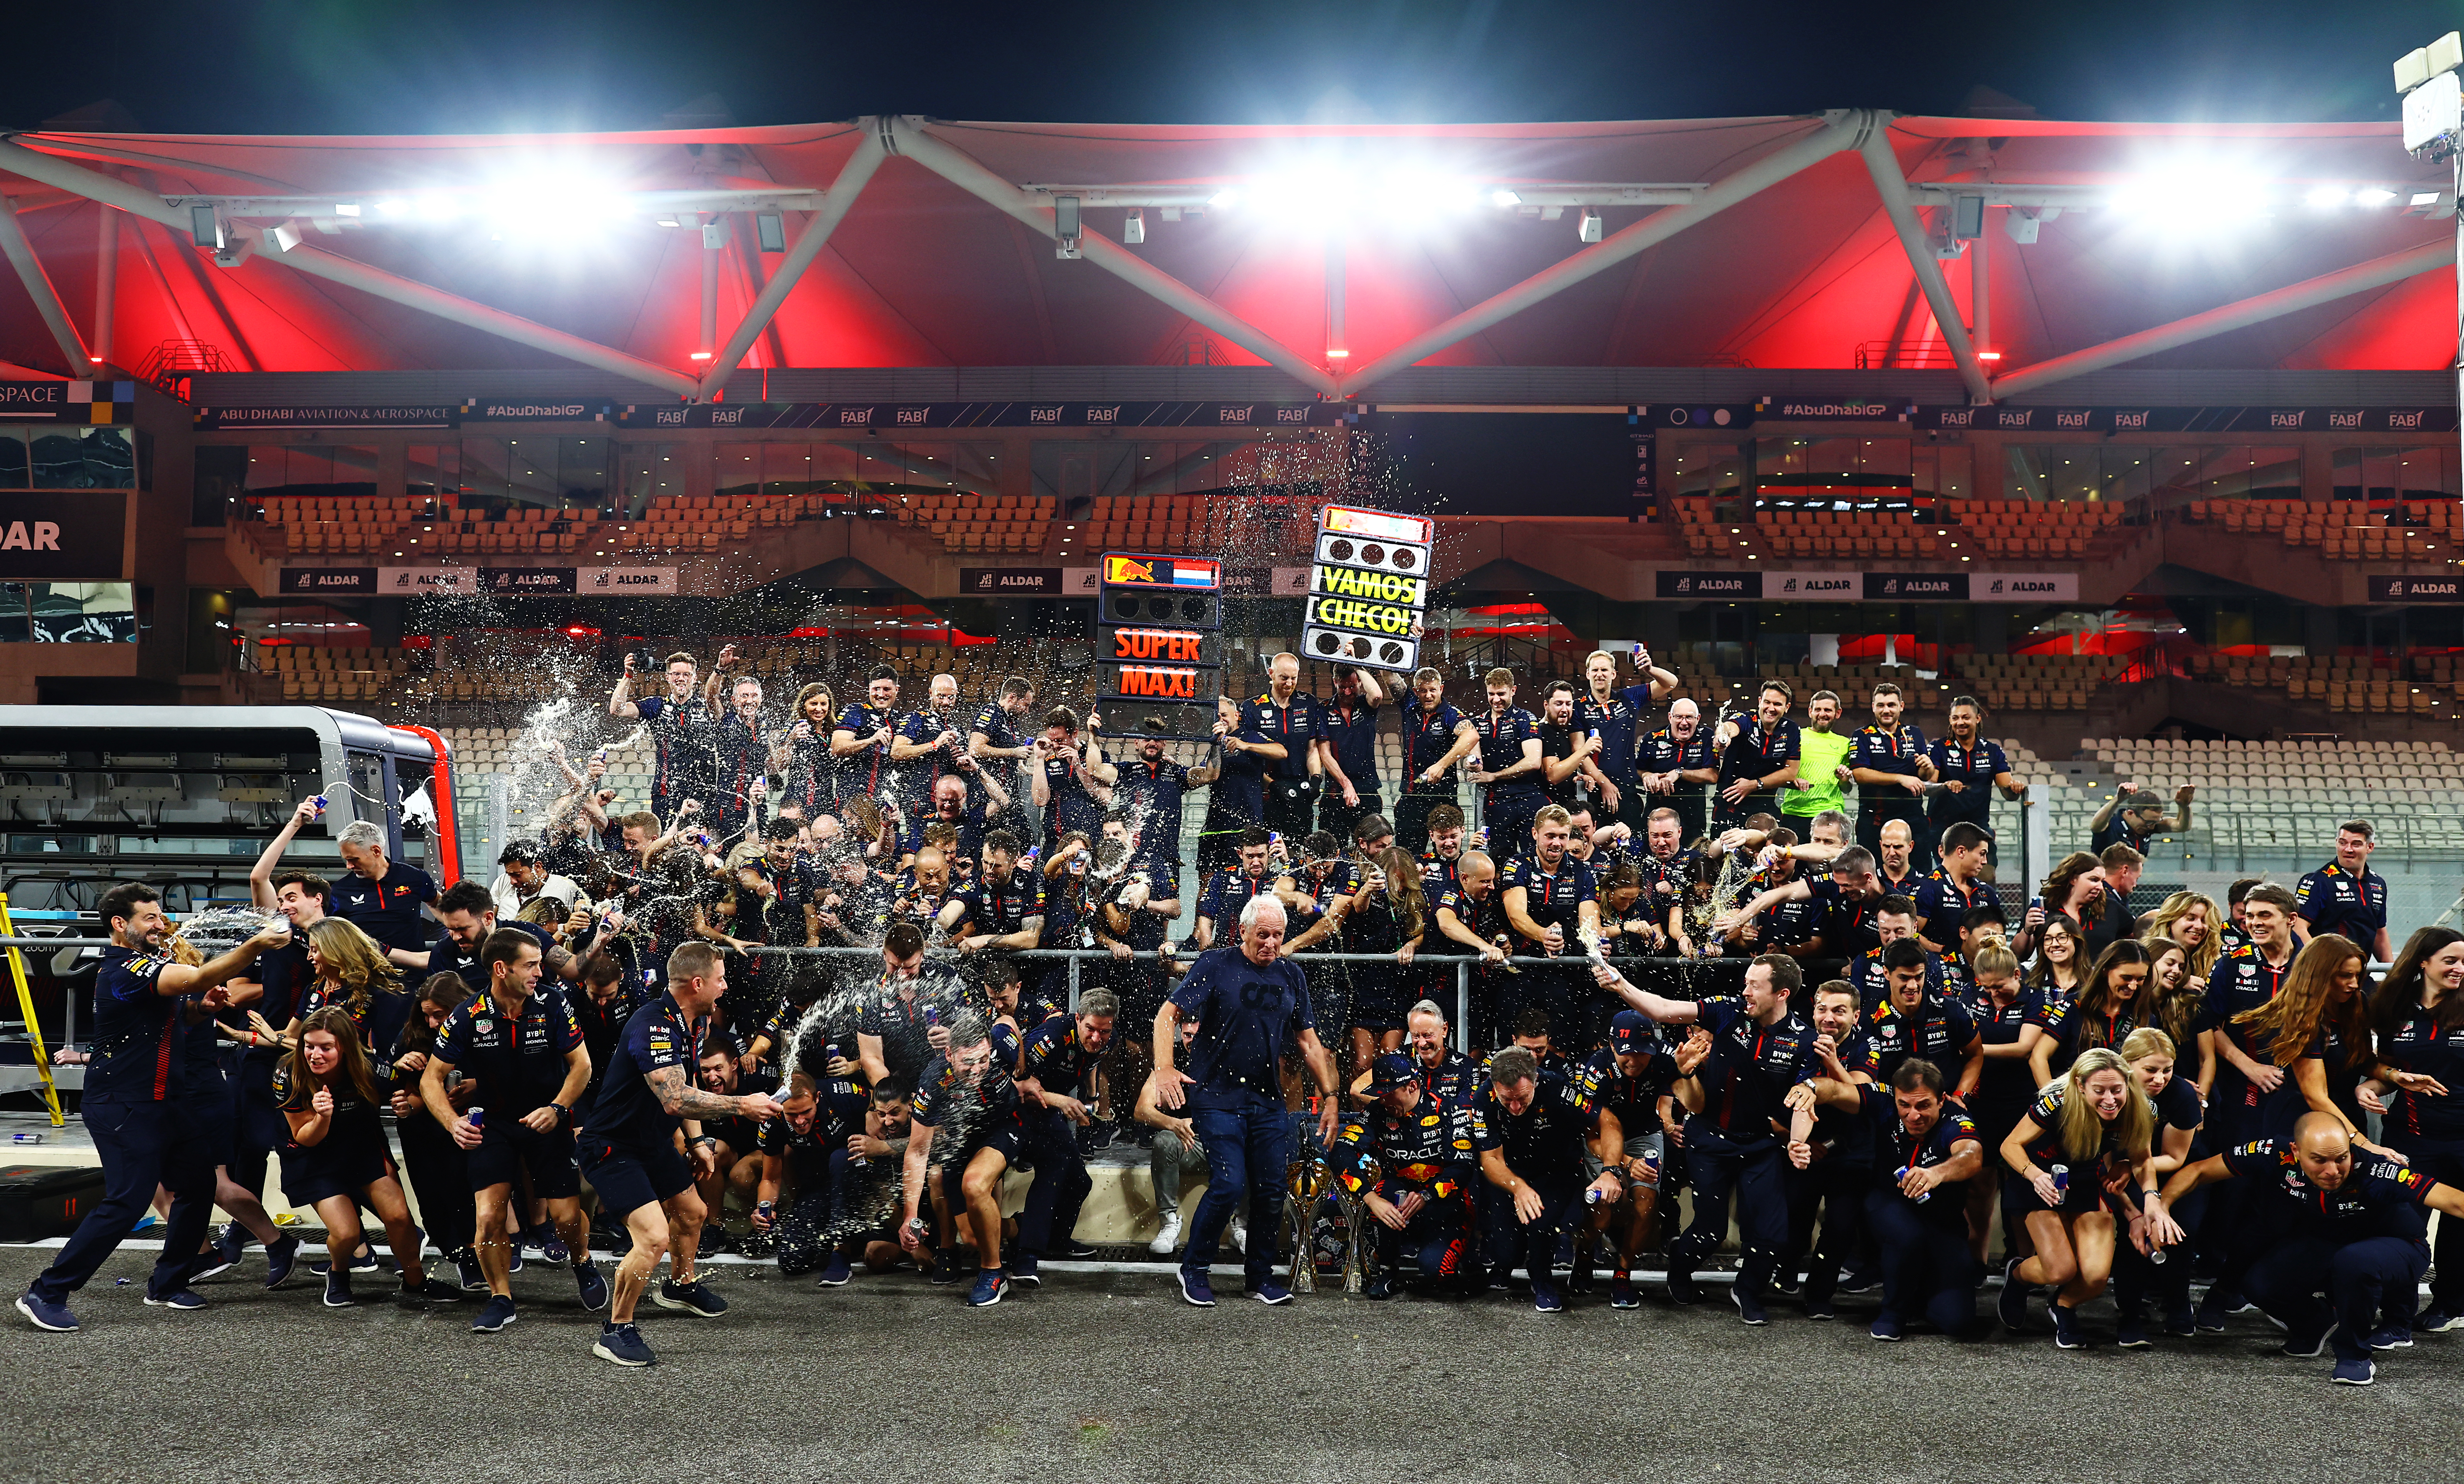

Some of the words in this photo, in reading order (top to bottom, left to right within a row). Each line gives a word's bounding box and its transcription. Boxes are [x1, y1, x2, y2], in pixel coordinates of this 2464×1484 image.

[220, 409, 247, 420] ABU
[250, 408, 293, 419] DHABI
[297, 409, 357, 419] AVIATION
[360, 409, 369, 418] &
[373, 408, 448, 418] AEROSPACE
[487, 405, 584, 417] #AbuDhabiGP
[1783, 405, 1886, 415] #AbuDhabiGP
[0, 521, 60, 550] AR
[318, 576, 359, 585] ALDAR
[418, 575, 458, 585] ALDAR
[517, 575, 558, 585] ALDAR
[617, 575, 658, 585] ALDAR
[1000, 576, 1043, 586] ALDAR
[1222, 576, 1252, 585] DAR
[1324, 566, 1415, 603] VAMOS
[1699, 581, 1742, 590] ALDAR
[1805, 581, 1850, 590] ALDAR
[1905, 582, 1949, 591] ALDAR
[2012, 582, 2056, 591] ALDAR
[2411, 584, 2456, 594] ALDAR
[1319, 599, 1409, 634] CHECO!
[1116, 628, 1200, 660] SUPER
[1121, 665, 1194, 697] MAX!
[2341, 868, 2354, 878] zoom
[1464, 892, 1474, 904] zoom
[2254, 947, 2262, 962] zoom
[615, 1004, 629, 1014] BYBIT
[1890, 1005, 1901, 1019] zoom
[676, 1013, 686, 1031] zoom
[527, 1029, 545, 1038] BYBIT
[650, 1026, 670, 1034] Mobil
[1619, 1029, 1630, 1038] 11
[1928, 1031, 1946, 1039] BYBIT
[1043, 1035, 1055, 1049] Mobil
[1773, 1051, 1794, 1059] BYBIT
[1589, 1065, 1603, 1079] Mobil
[1612, 1062, 1622, 1079] zoom
[919, 1087, 931, 1100] Mobil
[828, 1117, 839, 1130] BYBIT
[1453, 1115, 1469, 1125] ROKT
[831, 1122, 845, 1135] HONDA
[1423, 1128, 1441, 1139] BYBIT
[1386, 1144, 1443, 1160] ORACLE
[2377, 1163, 2388, 1177] citrix
